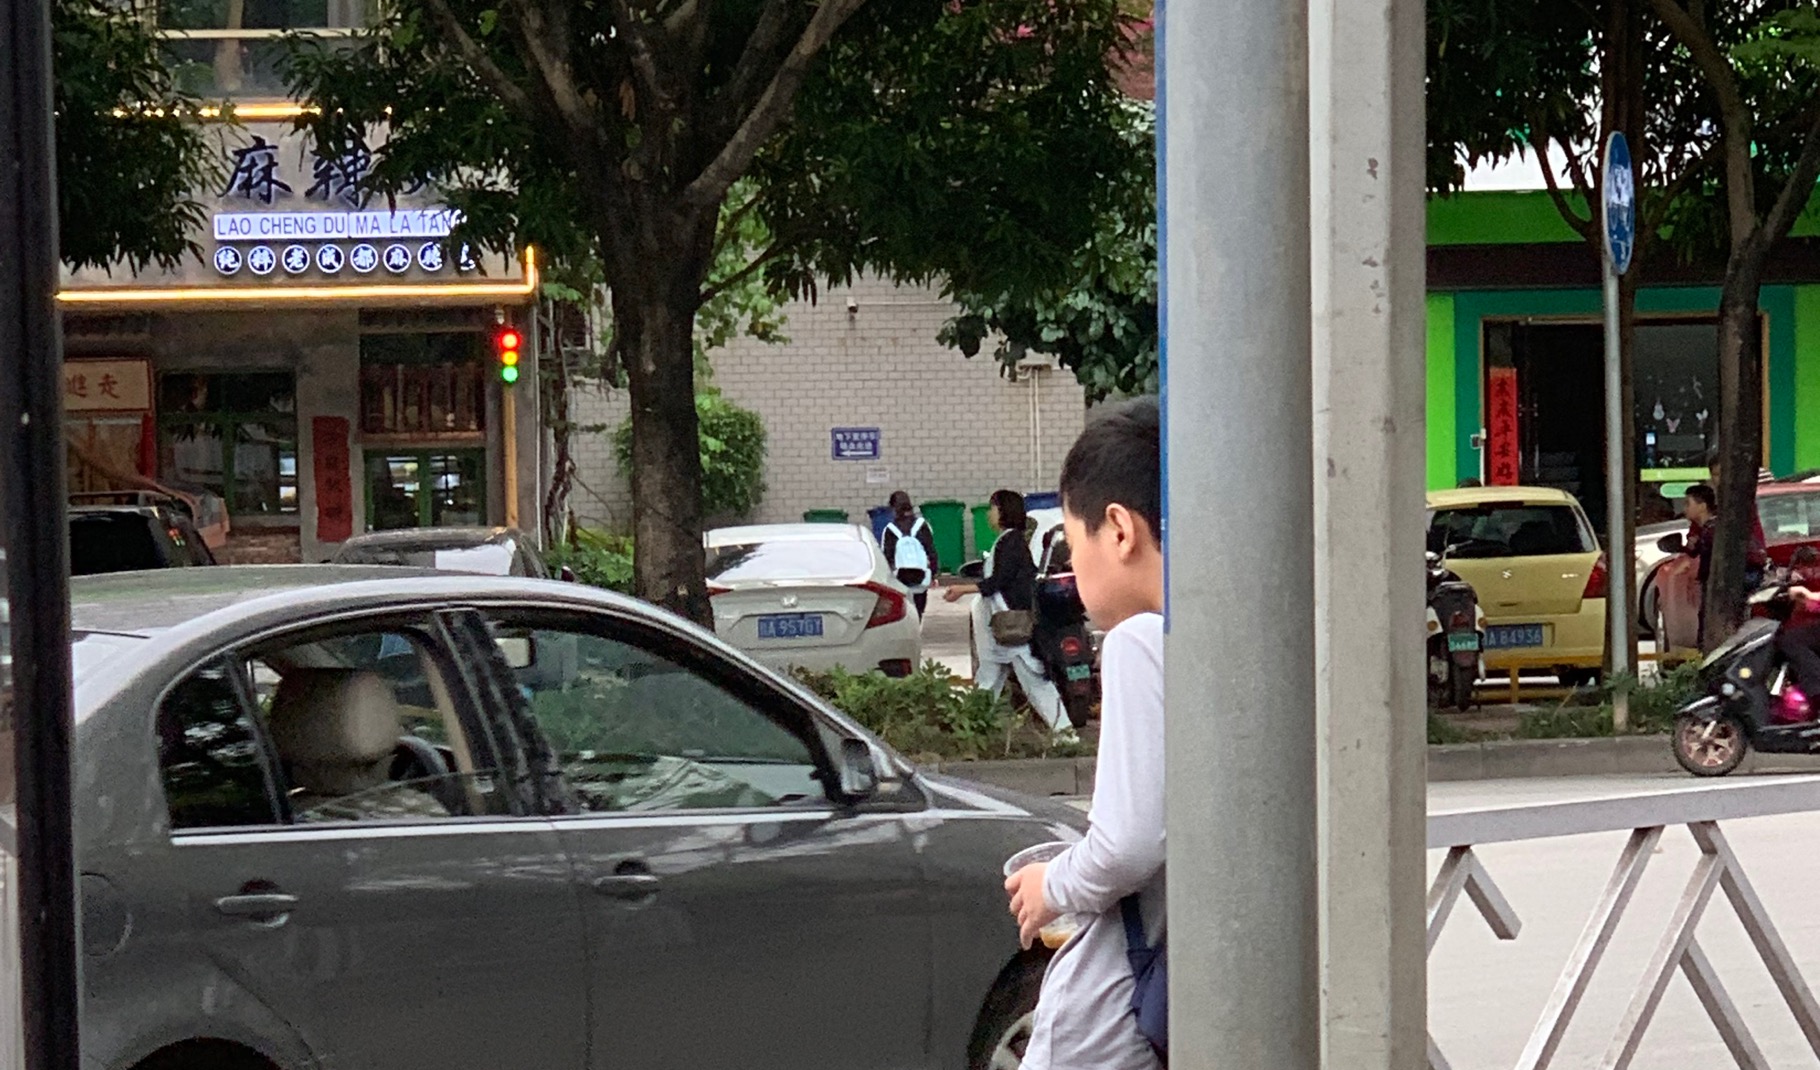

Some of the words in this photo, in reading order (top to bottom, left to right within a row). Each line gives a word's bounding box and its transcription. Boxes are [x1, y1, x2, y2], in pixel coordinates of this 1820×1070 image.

[217, 134, 431, 211] 麻辣
[217, 217, 251, 235] LAO
[260, 216, 316, 234] CHENG
[324, 216, 345, 234] DU
[356, 216, 381, 234] MA
[390, 214, 412, 233] LA
[419, 213, 464, 233] TAN
